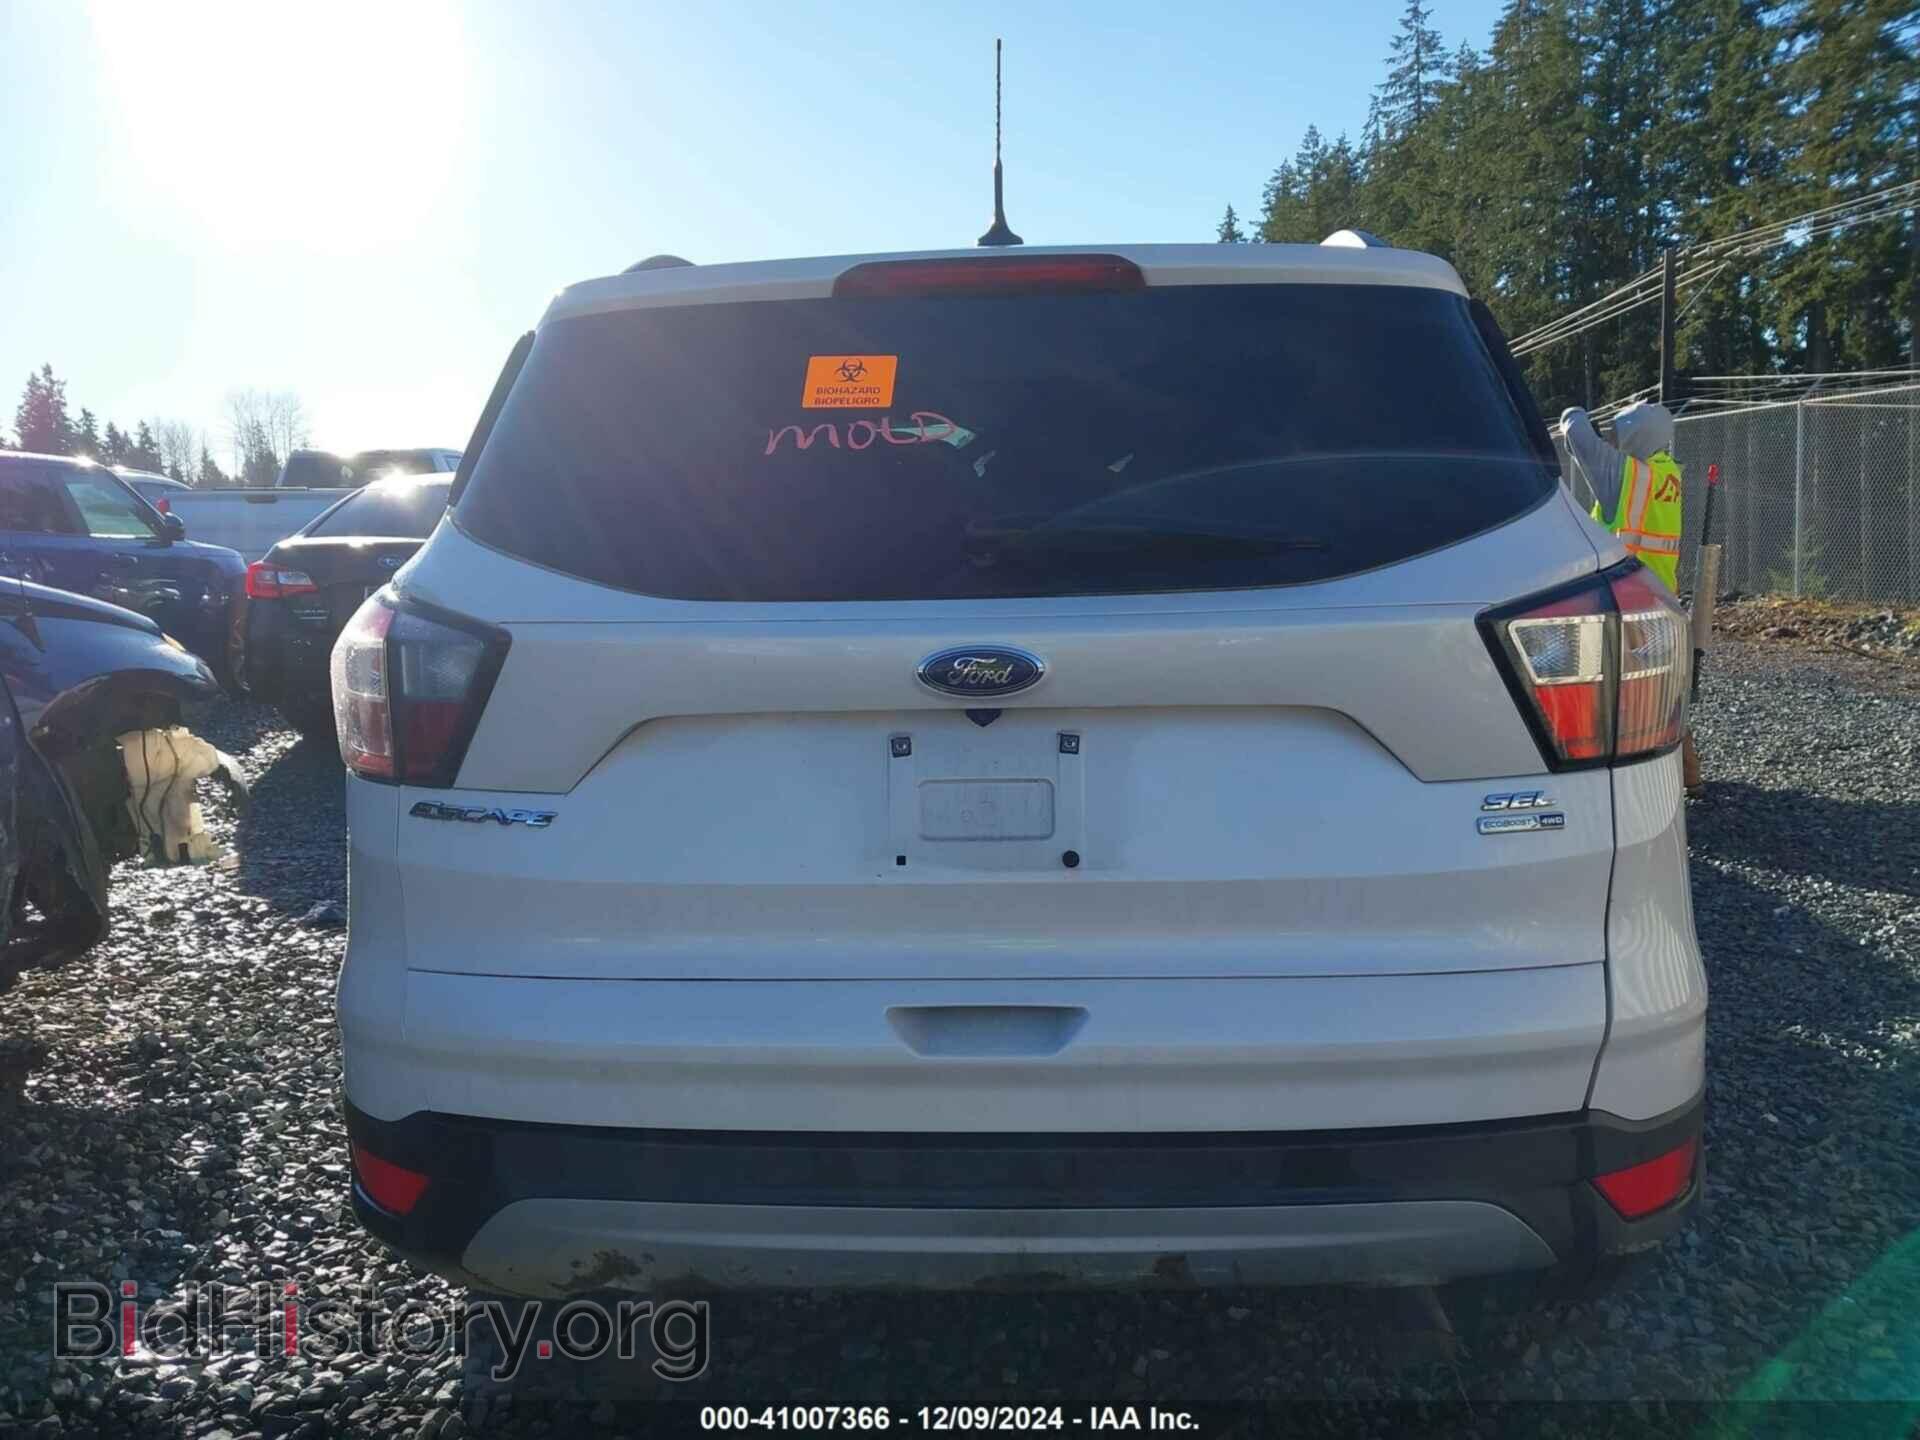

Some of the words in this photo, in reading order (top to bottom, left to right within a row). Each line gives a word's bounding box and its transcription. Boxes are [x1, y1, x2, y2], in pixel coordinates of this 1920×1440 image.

[814, 397, 880, 405] BIOPELIGRO
[816, 386, 881, 395] BIOHAZARD
[947, 657, 1014, 685] Ford
[1481, 790, 1557, 811] SEL
[409, 801, 559, 828] ESCAPE
